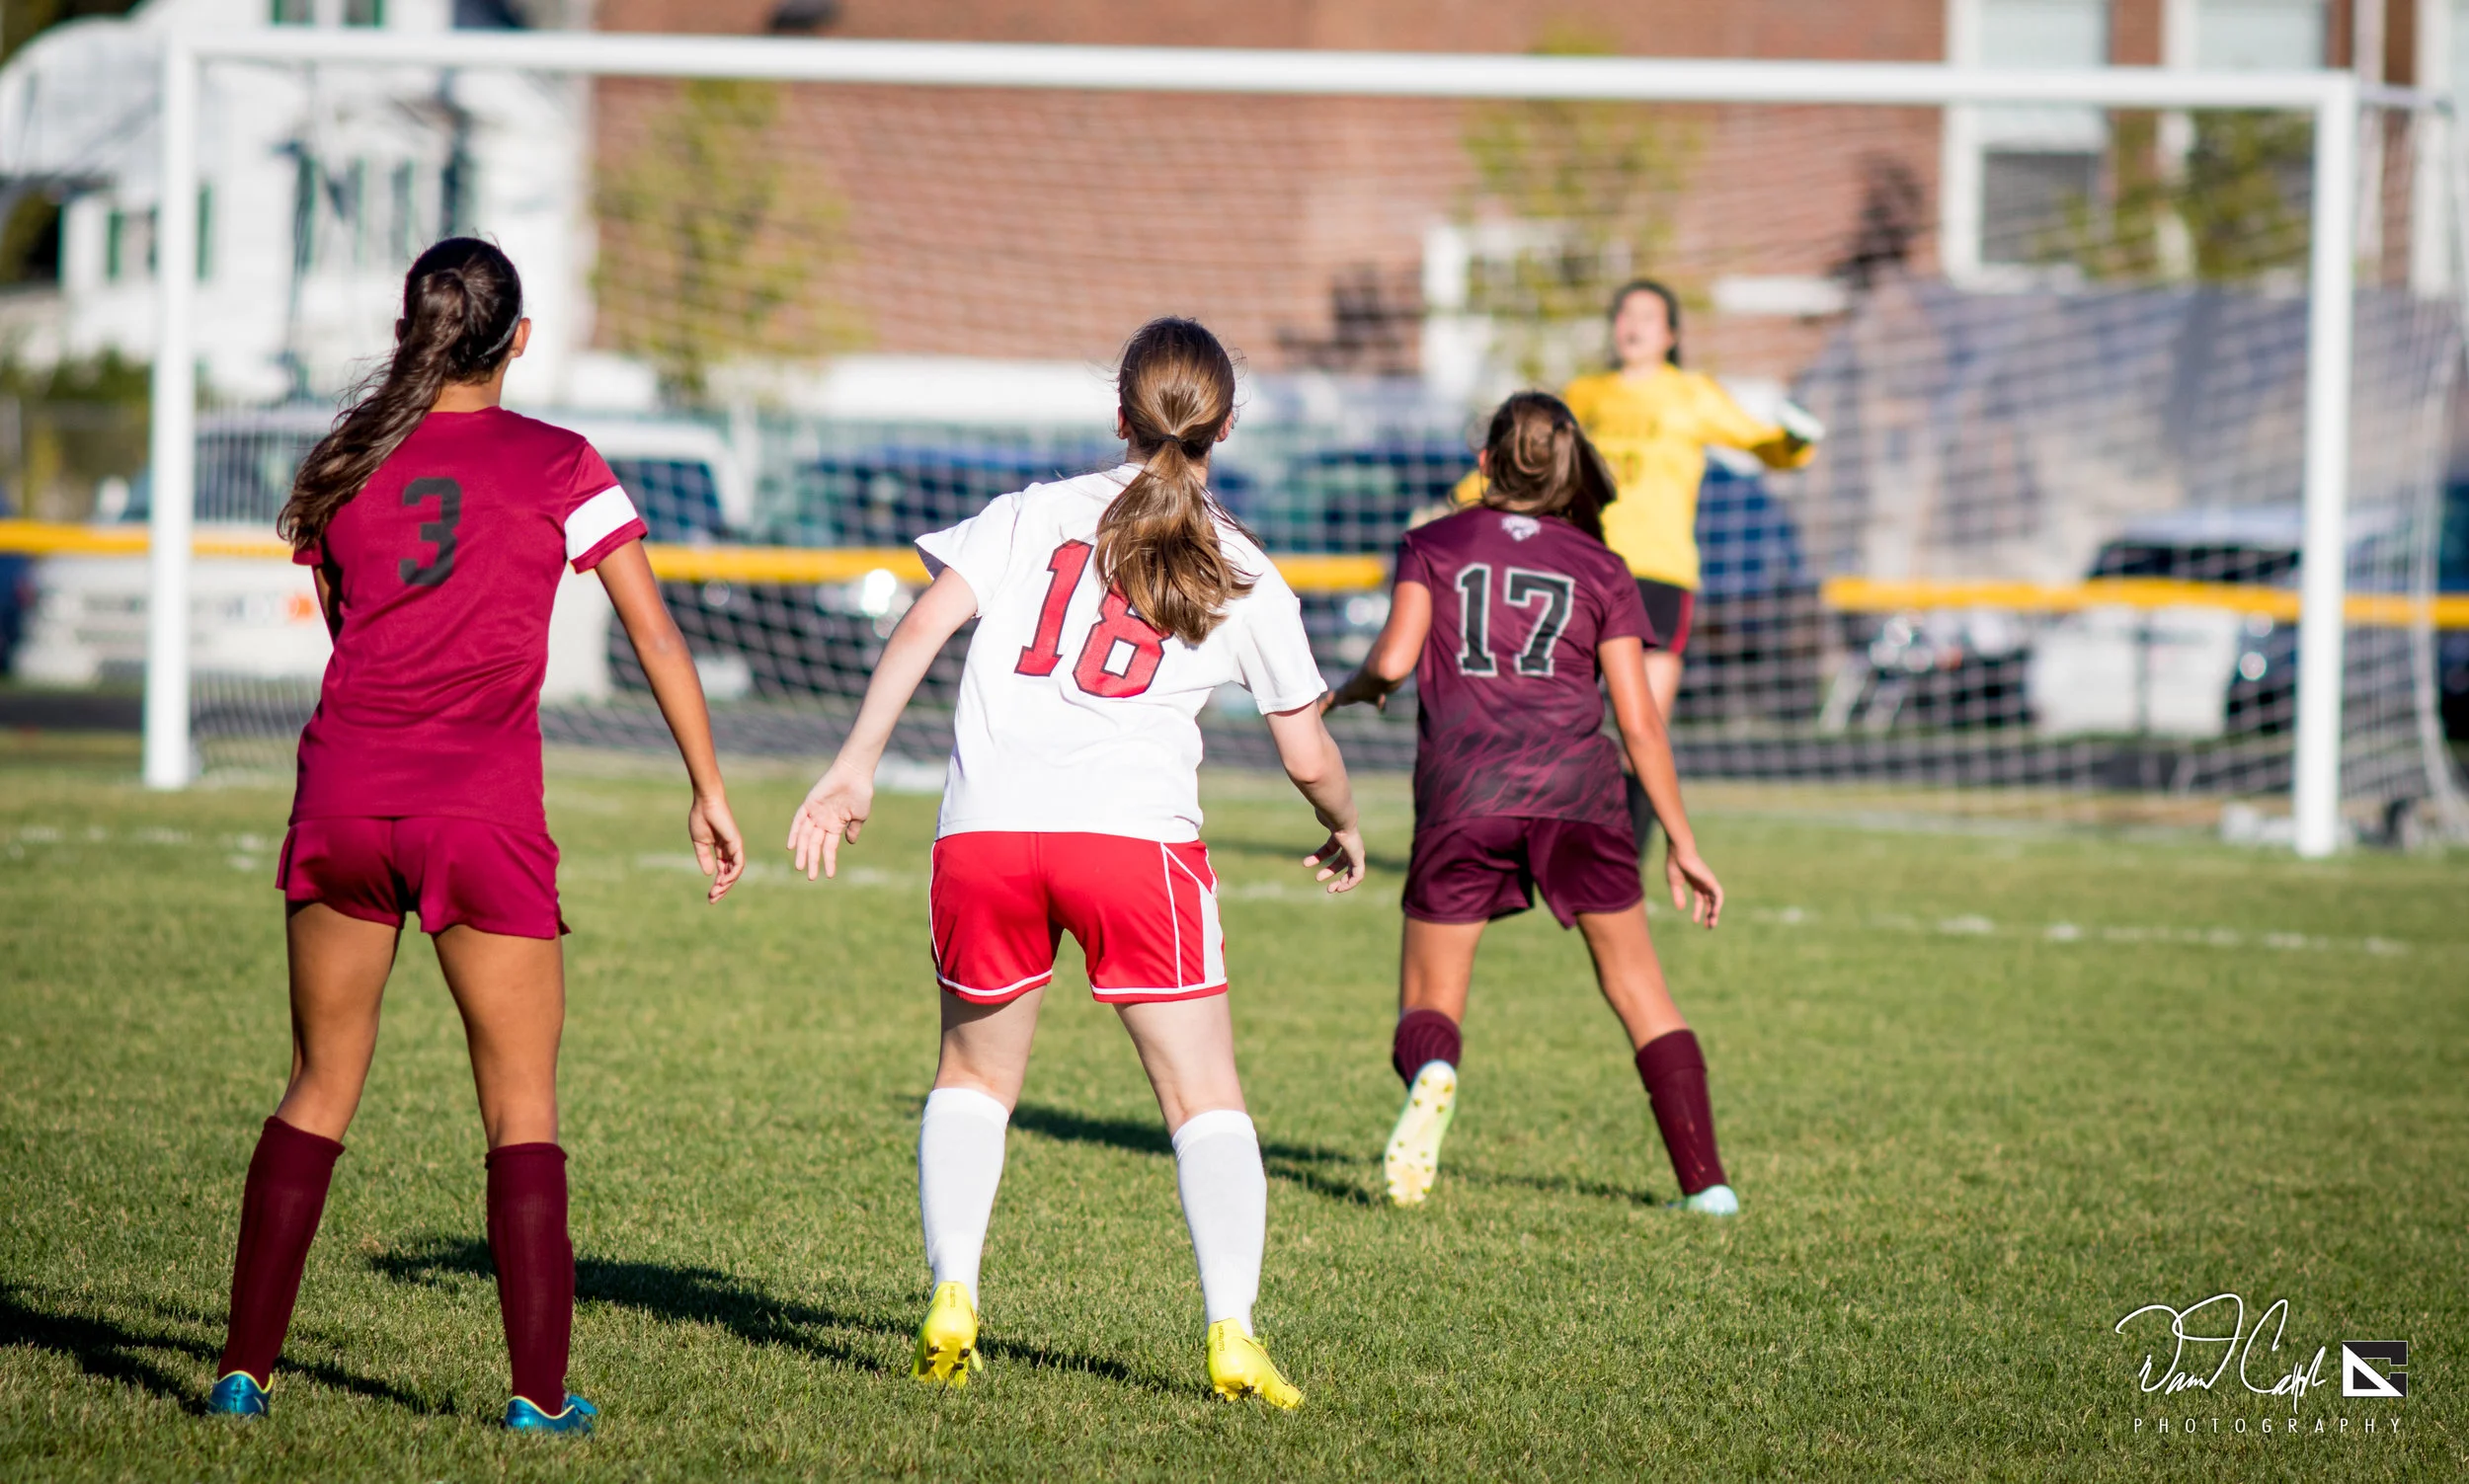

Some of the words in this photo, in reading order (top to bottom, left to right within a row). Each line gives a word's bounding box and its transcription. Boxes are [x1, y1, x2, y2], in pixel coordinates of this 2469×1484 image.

[399, 477, 461, 586] 3
[1013, 538, 1174, 698] 18
[1455, 562, 1575, 677] 17
